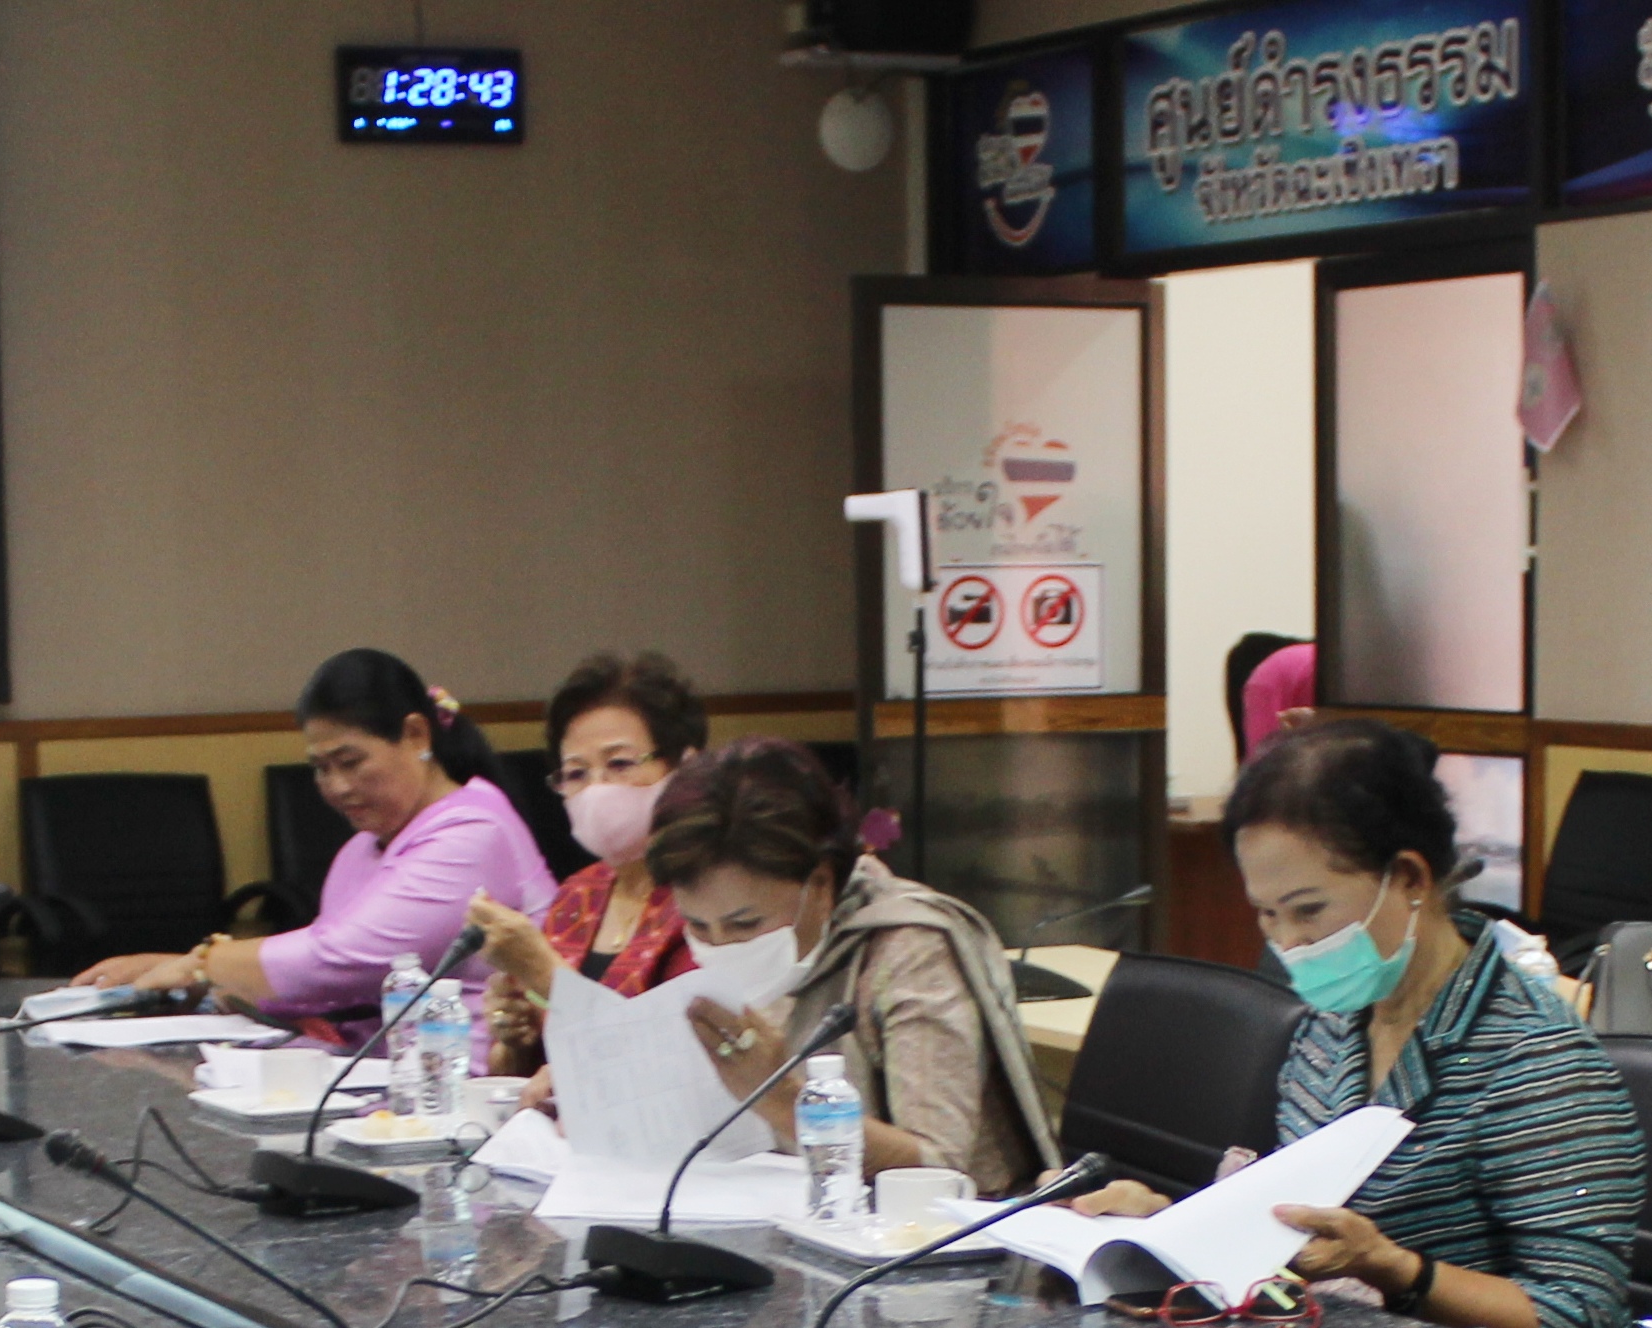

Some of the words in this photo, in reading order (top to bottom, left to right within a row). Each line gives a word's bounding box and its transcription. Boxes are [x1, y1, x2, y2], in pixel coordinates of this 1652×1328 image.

[382, 67, 516, 109] 1:28:43
[1146, 18, 1520, 192] ศูนย์ดำรงธรรม
[1194, 137, 1459, 225] จังหวัดฉะเชิงเทรา
